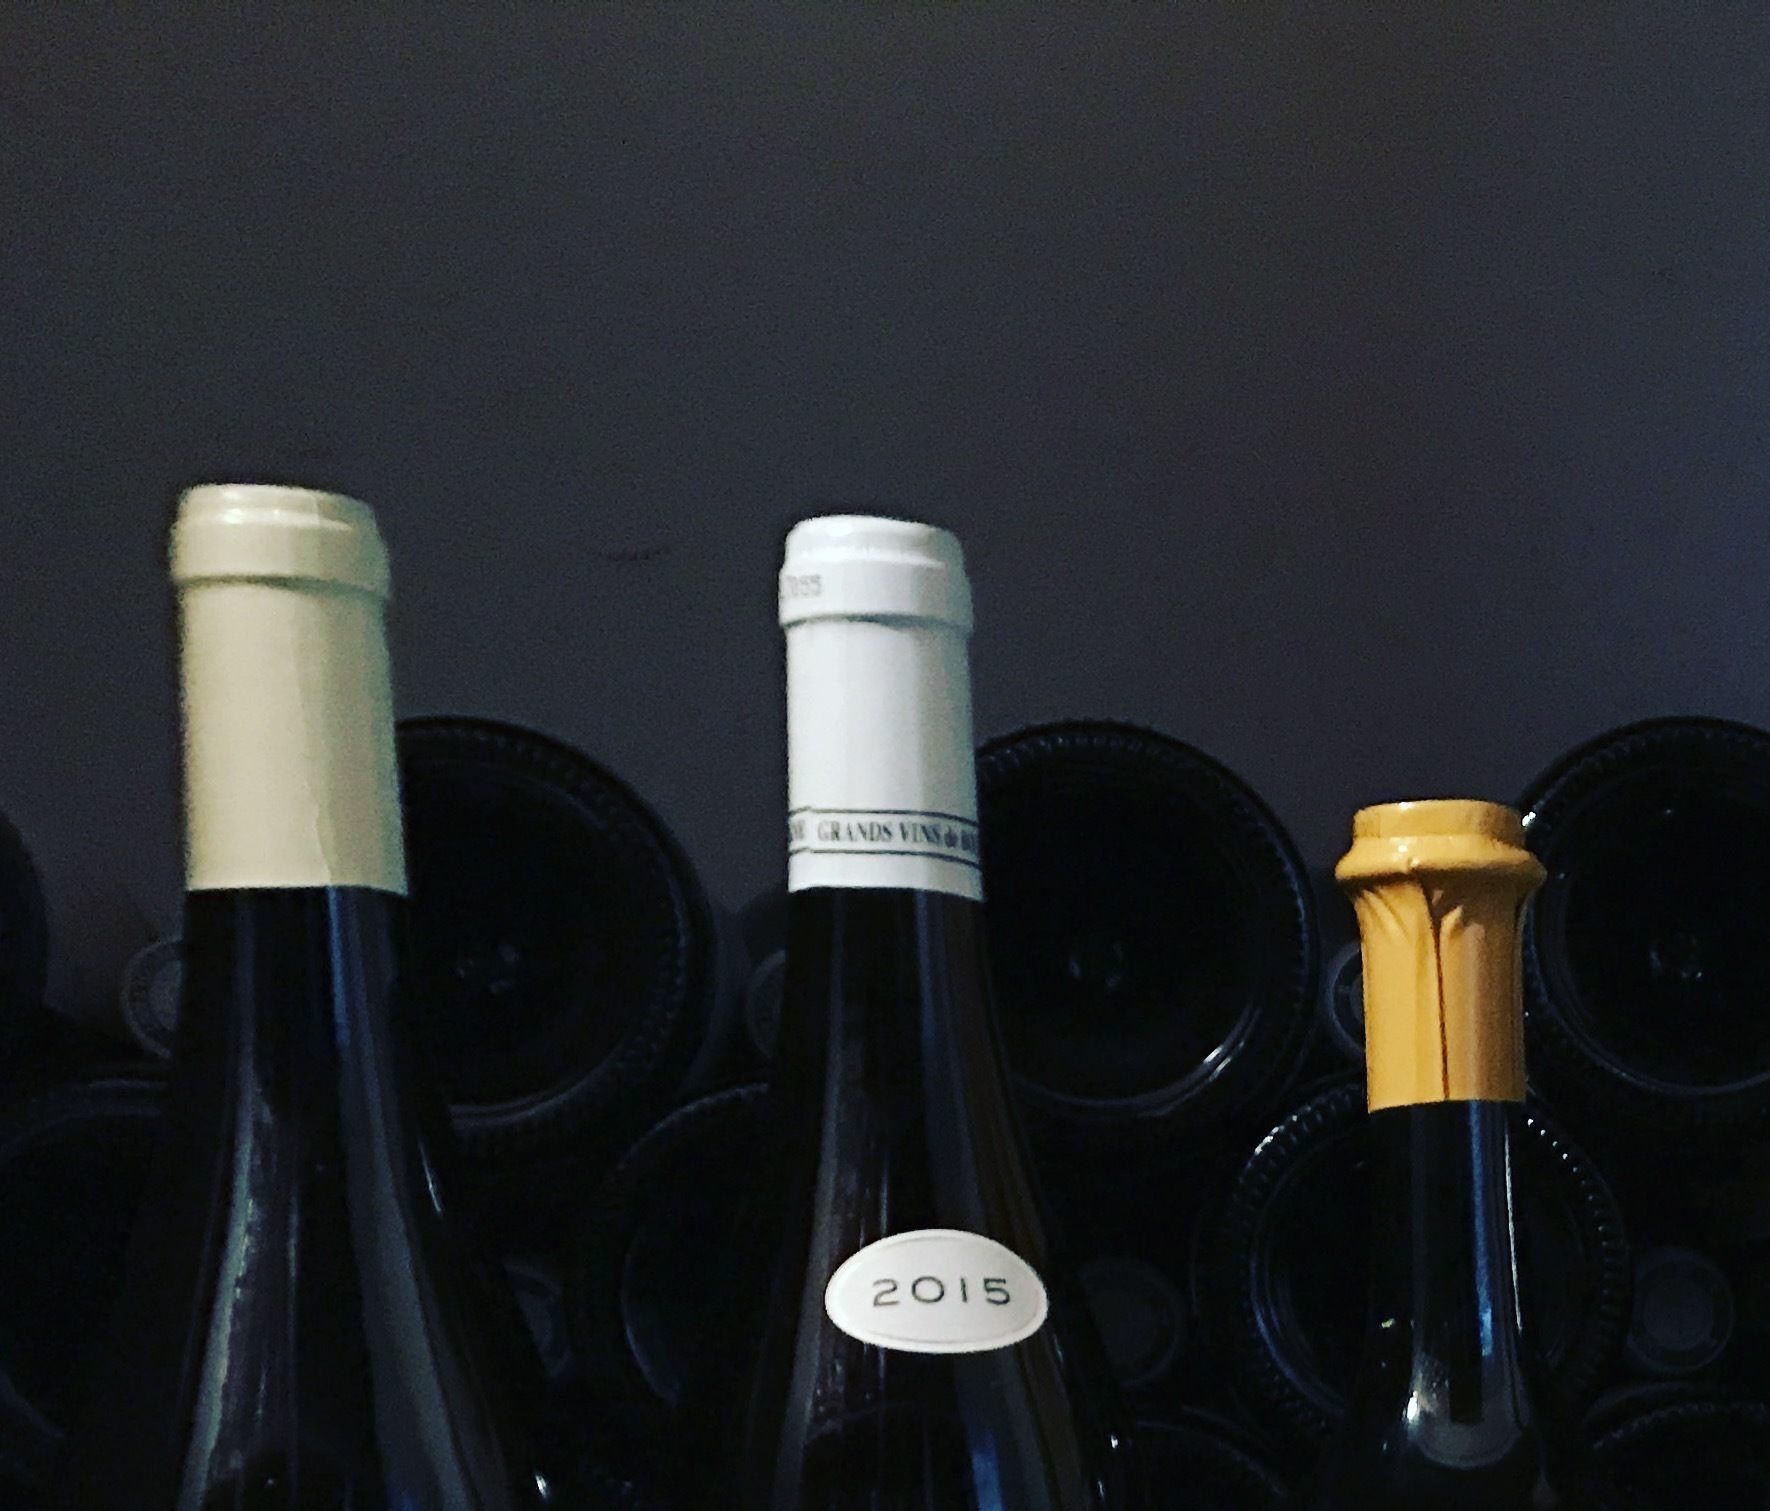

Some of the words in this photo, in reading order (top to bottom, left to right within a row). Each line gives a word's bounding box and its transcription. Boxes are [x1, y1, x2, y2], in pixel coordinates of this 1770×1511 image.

[817, 820, 892, 844] GRANDS
[899, 821, 941, 845] VINS
[872, 1275, 1011, 1308] 2015
